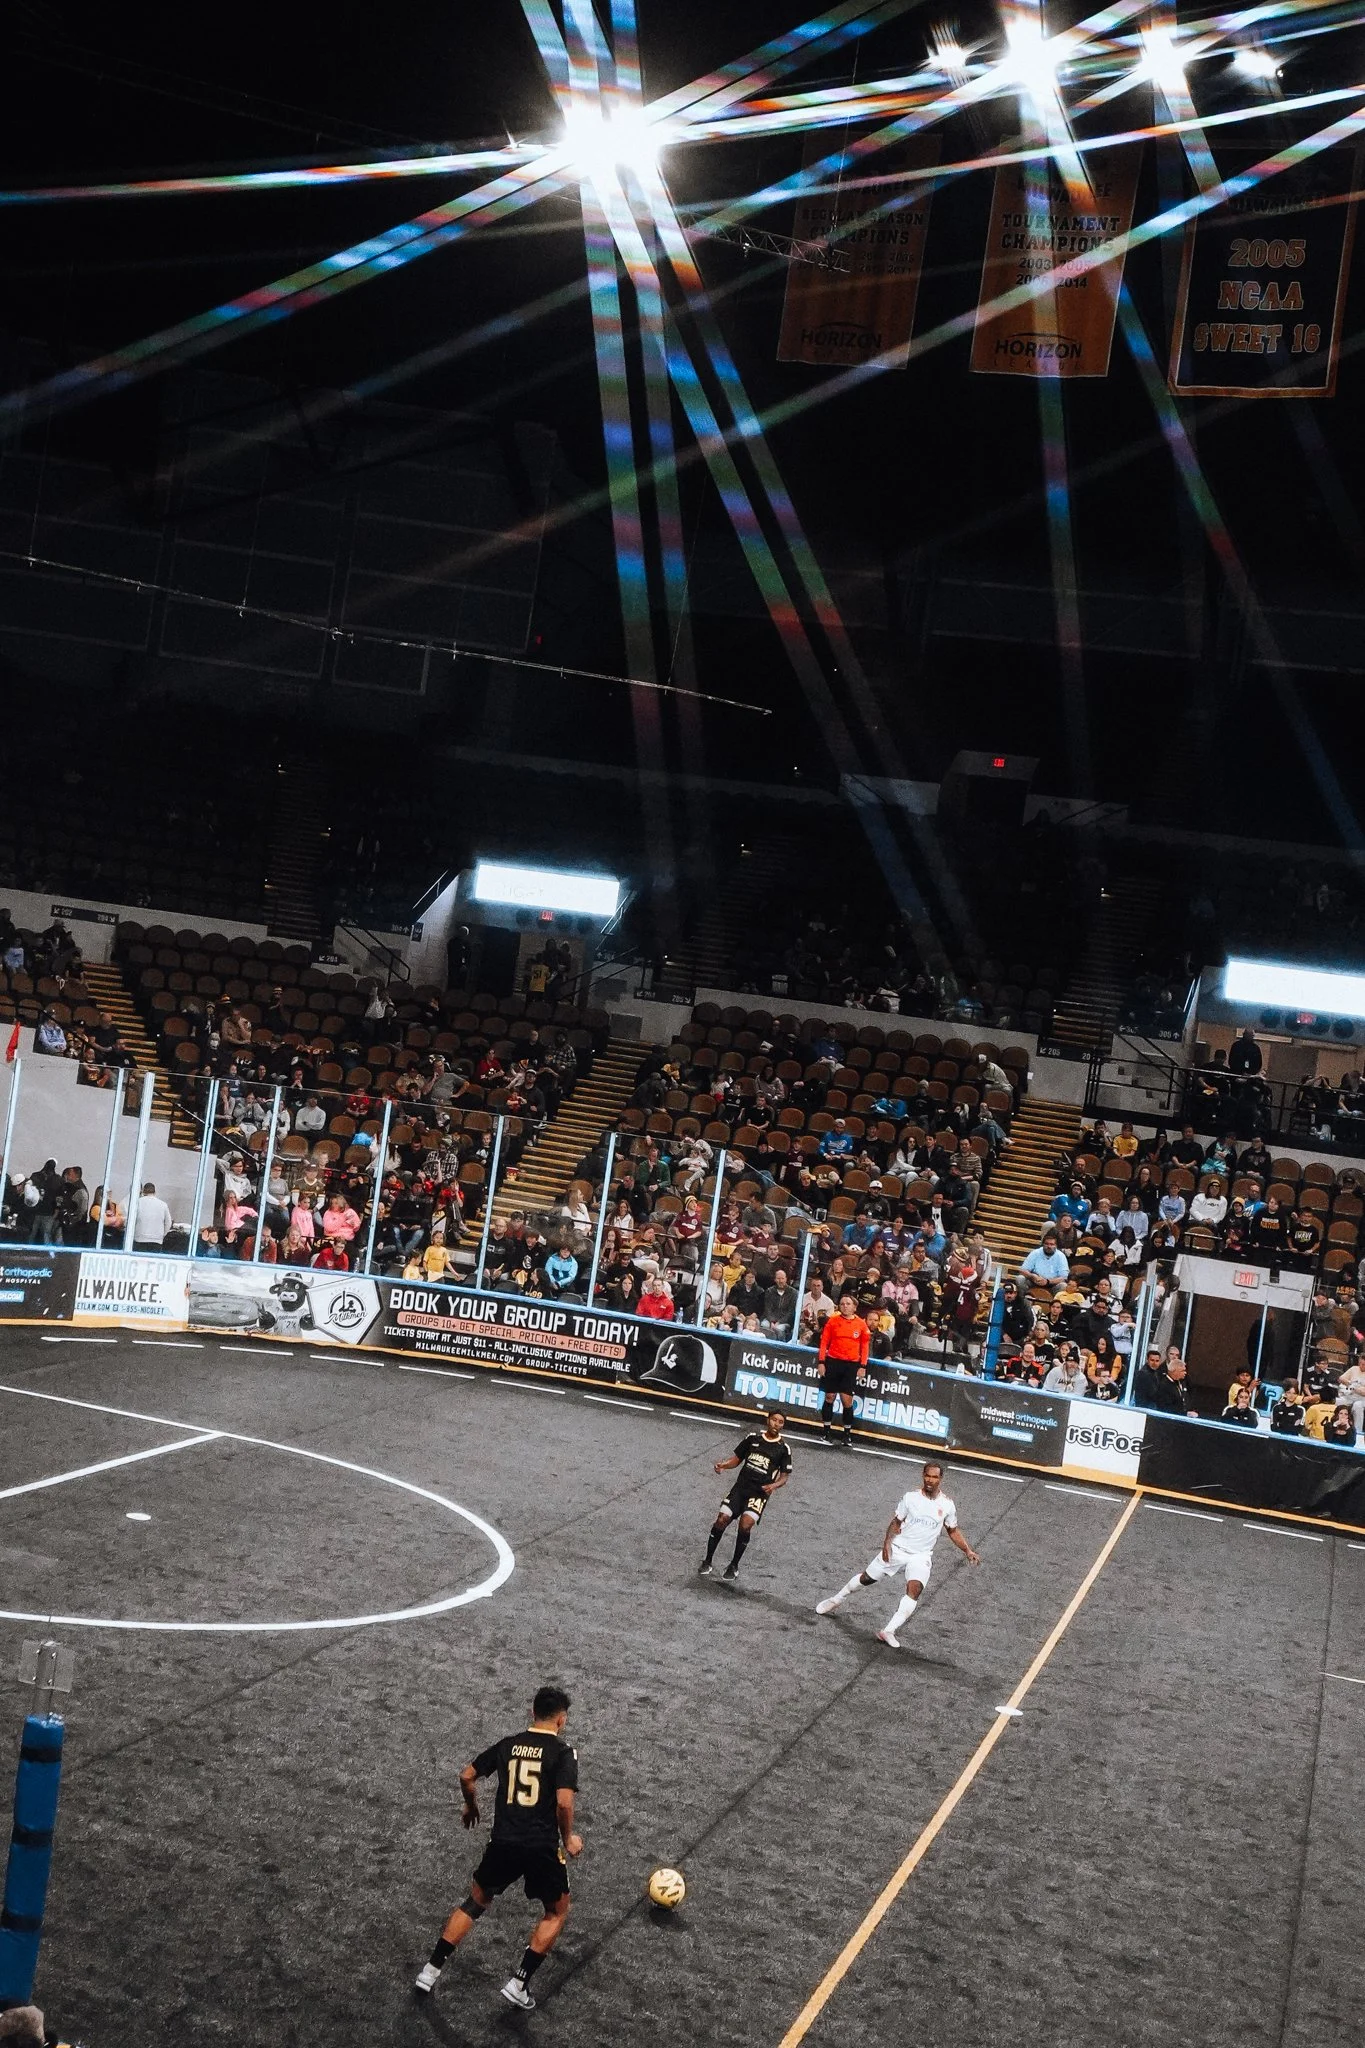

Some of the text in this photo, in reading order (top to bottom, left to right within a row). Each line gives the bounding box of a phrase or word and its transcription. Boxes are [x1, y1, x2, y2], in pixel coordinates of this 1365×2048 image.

[1001, 214, 1121, 233] TOURNAMENT
[1001, 233, 1114, 253] CHAMPIONS
[1227, 238, 1307, 268] 2005
[1217, 280, 1304, 311] NCAA
[801, 329, 882, 348] HORIZON
[995, 339, 1082, 358] HORIZON
[1193, 323, 1321, 354] SWEET 16
[4, 1267, 53, 1280] orthopedic
[5, 1277, 41, 1285] HOSPITAL
[145, 1261, 178, 1282] FOR
[389, 1288, 441, 1314] BOOK
[447, 1296, 498, 1322] YOUR
[503, 1304, 567, 1333] GROUP
[573, 1315, 640, 1347] TODAY!
[404, 1314, 439, 1327] GROUPS
[441, 1319, 456, 1329] 10+
[460, 1321, 476, 1332] GET
[478, 1324, 516, 1339] SPECIAL
[518, 1330, 557, 1346] PRICING
[568, 1339, 590, 1351] FREE
[383, 1325, 415, 1338] TICKETS
[416, 1331, 440, 1341] START
[441, 1333, 452, 1342] AT
[453, 1335, 472, 1346] JUST
[473, 1337, 487, 1348] $11
[494, 1342, 553, 1360] ALL-INCLUSIVE
[554, 1351, 588, 1365] OPTIONS
[588, 1356, 631, 1373] AVAILABLE
[415, 1342, 515, 1362] MILWAUKEEMILKMEN.COM
[525, 1358, 588, 1376] GROUP-TICKETS
[742, 1352, 769, 1370] Kick
[771, 1357, 802, 1375] joint
[881, 1380, 910, 1396] pain
[738, 1373, 769, 1399] TO
[776, 1380, 820, 1409] THE
[980, 1414, 1048, 1432] SPECIALTY HOSPITAL
[981, 1406, 1058, 1428] midwest orthopedic
[511, 1744, 543, 1759] CORREA
[506, 1758, 543, 1808] 15
